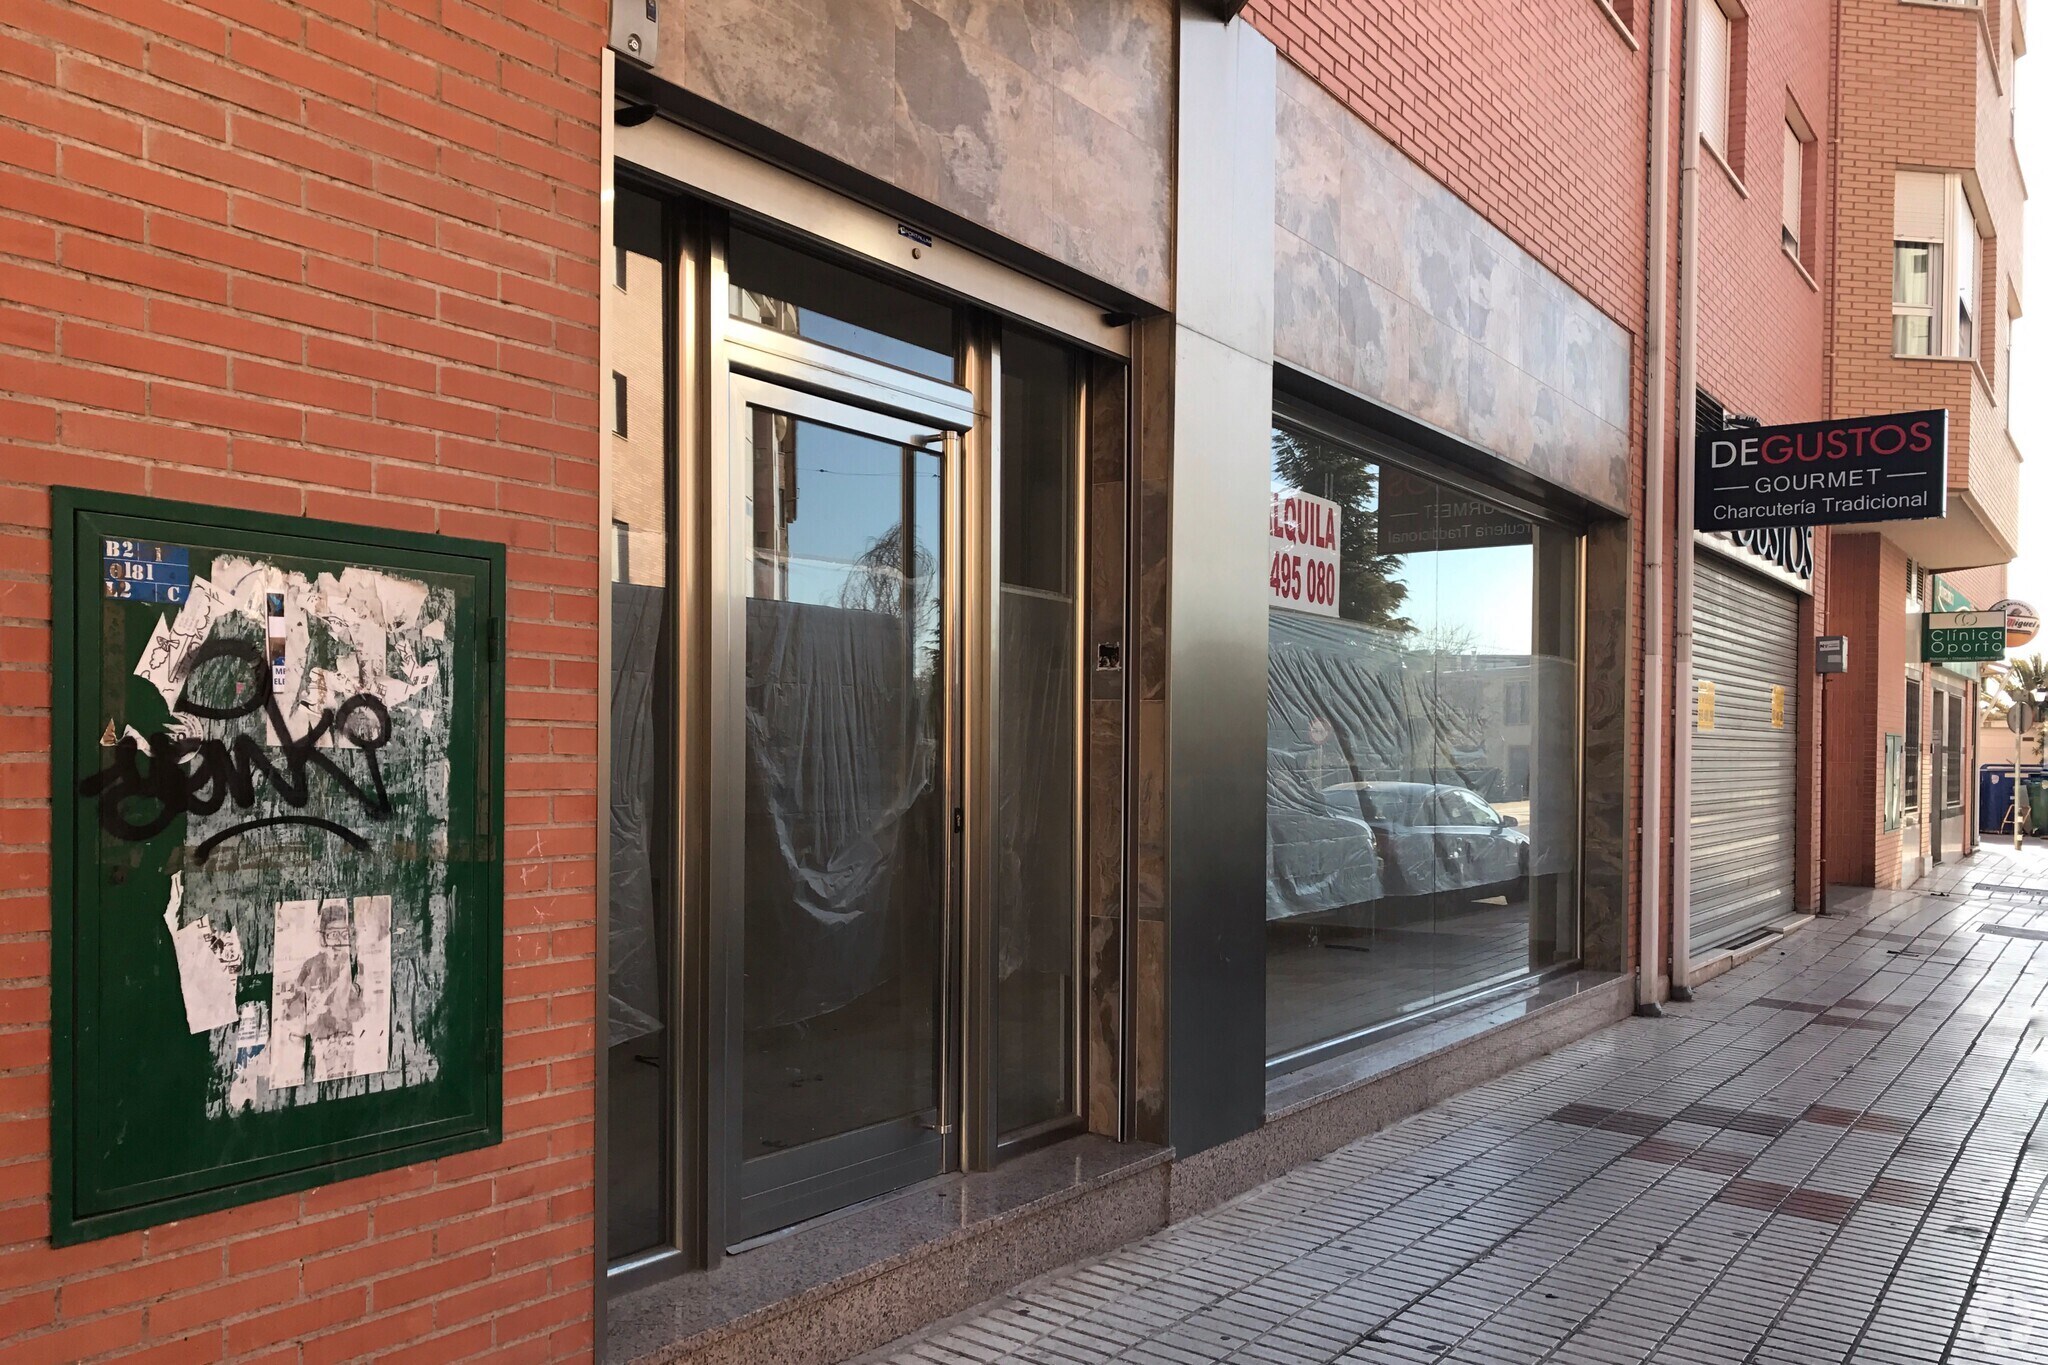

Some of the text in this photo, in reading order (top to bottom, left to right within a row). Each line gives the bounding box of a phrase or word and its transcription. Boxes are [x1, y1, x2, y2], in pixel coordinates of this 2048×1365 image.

[1711, 421, 1932, 469] DEGUSTOS
[1754, 468, 1882, 494] GOURMET
[1713, 491, 1928, 520] Charcutería Tradicional
[1270, 492, 1336, 550] LQUILA
[1270, 551, 1335, 606] 495 080
[167, 586, 180, 602] C
[1931, 629, 2003, 642] Clínica
[1931, 641, 2003, 655] Oporto
